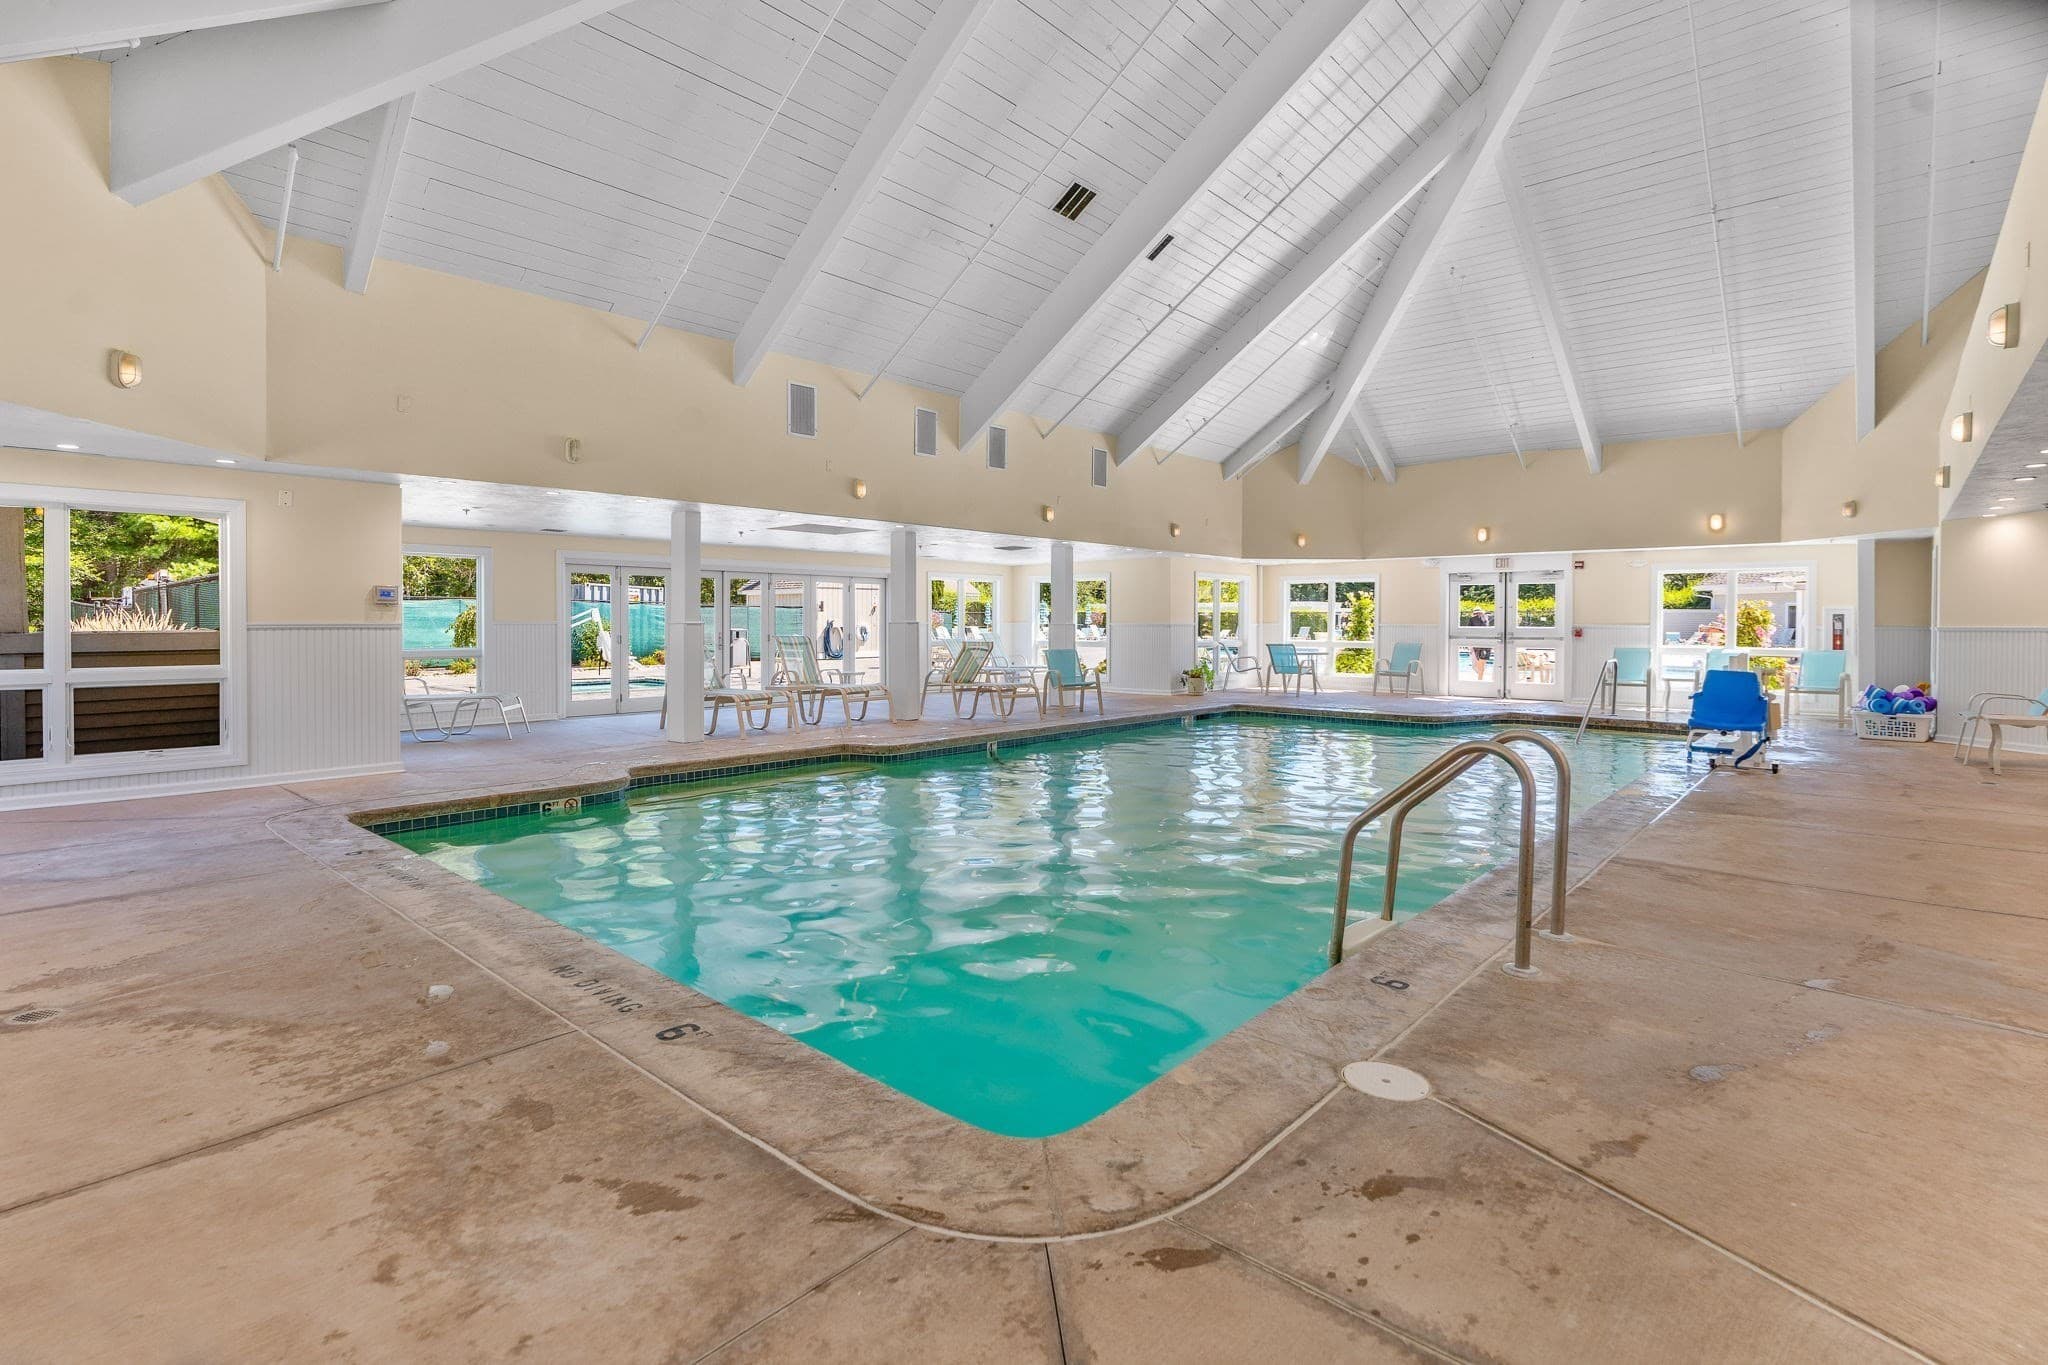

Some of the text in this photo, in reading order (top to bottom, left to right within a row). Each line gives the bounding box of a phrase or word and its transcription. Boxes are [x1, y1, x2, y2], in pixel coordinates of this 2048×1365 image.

[1496, 558, 1510, 568] EXIT
[549, 964, 643, 1012] NO DIVING
[655, 1023, 701, 1041] 6
